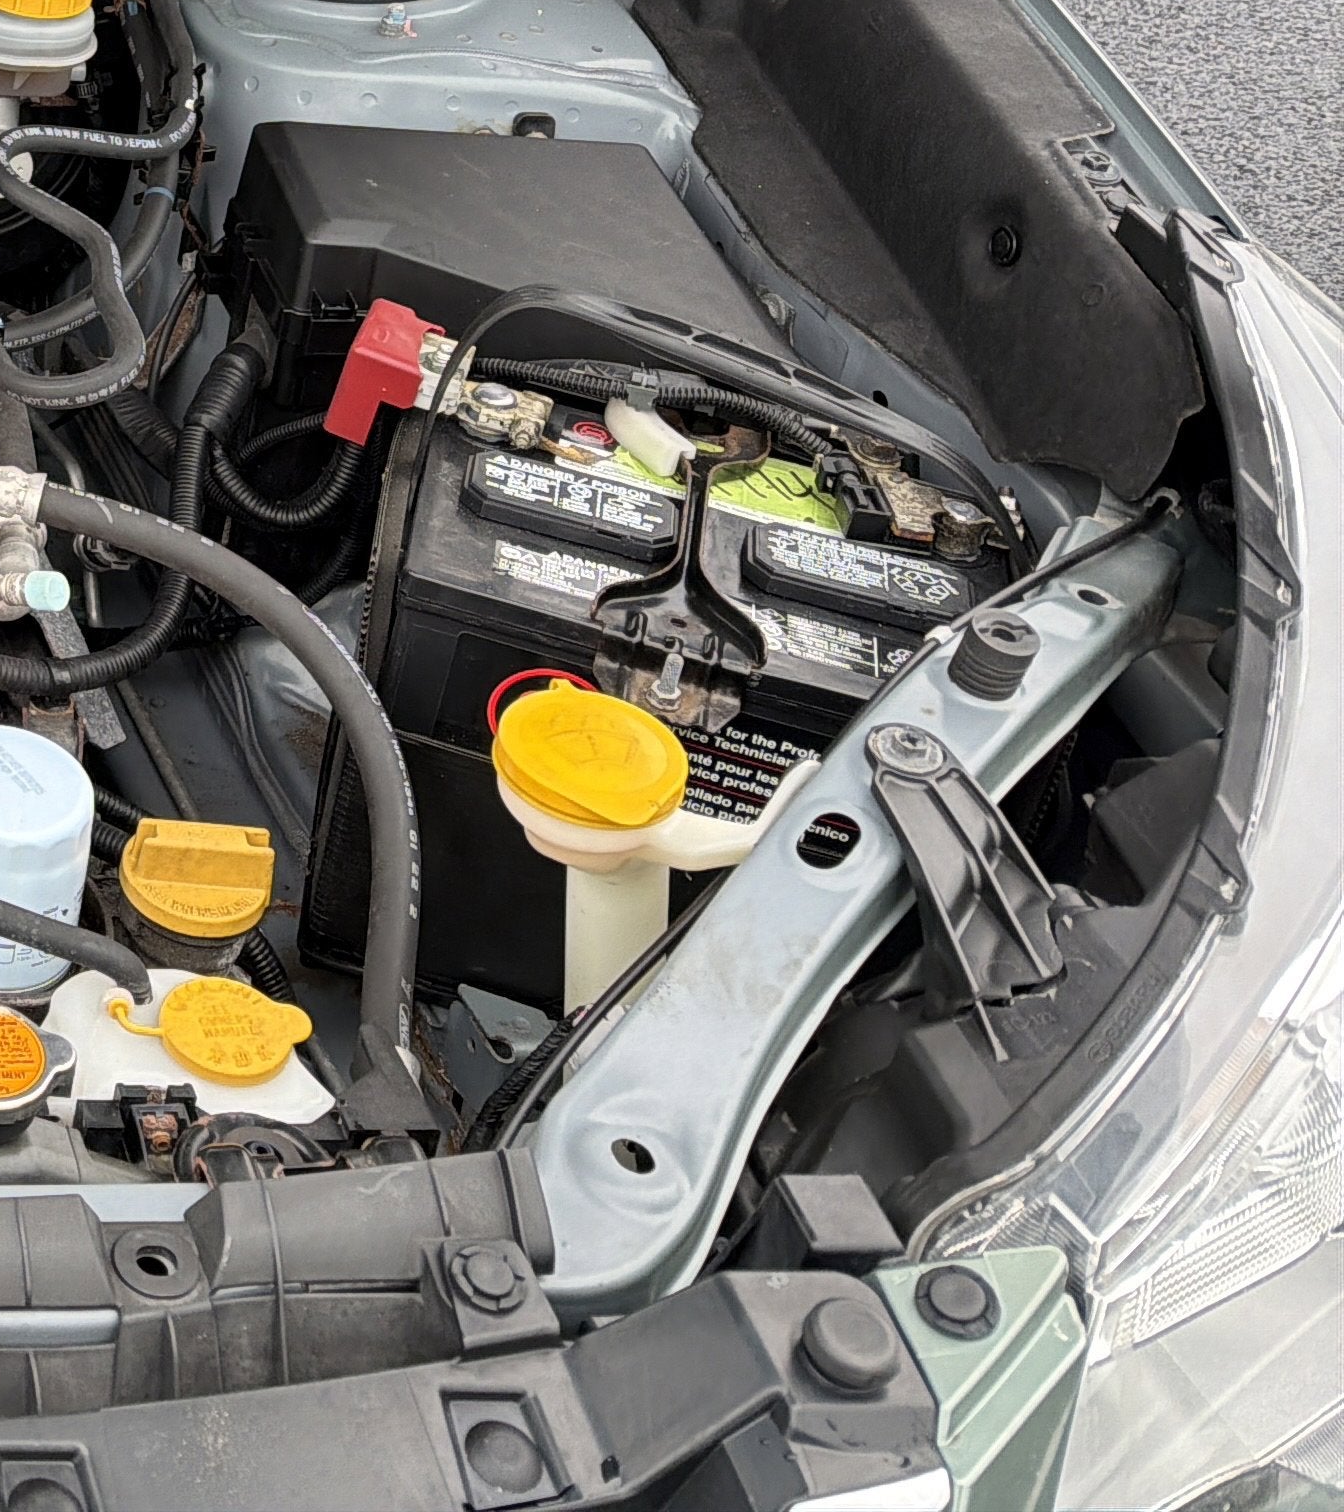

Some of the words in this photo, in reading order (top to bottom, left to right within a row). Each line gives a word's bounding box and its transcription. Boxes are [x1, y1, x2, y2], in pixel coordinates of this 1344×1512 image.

[83, 132, 107, 144] FUEL
[21, 395, 43, 406] NOT
[511, 457, 575, 482] DANGER
[591, 479, 651, 501] POISON
[725, 726, 749, 741] for
[751, 733, 777, 749] the
[715, 761, 753, 777] pour
[755, 770, 779, 785] les
